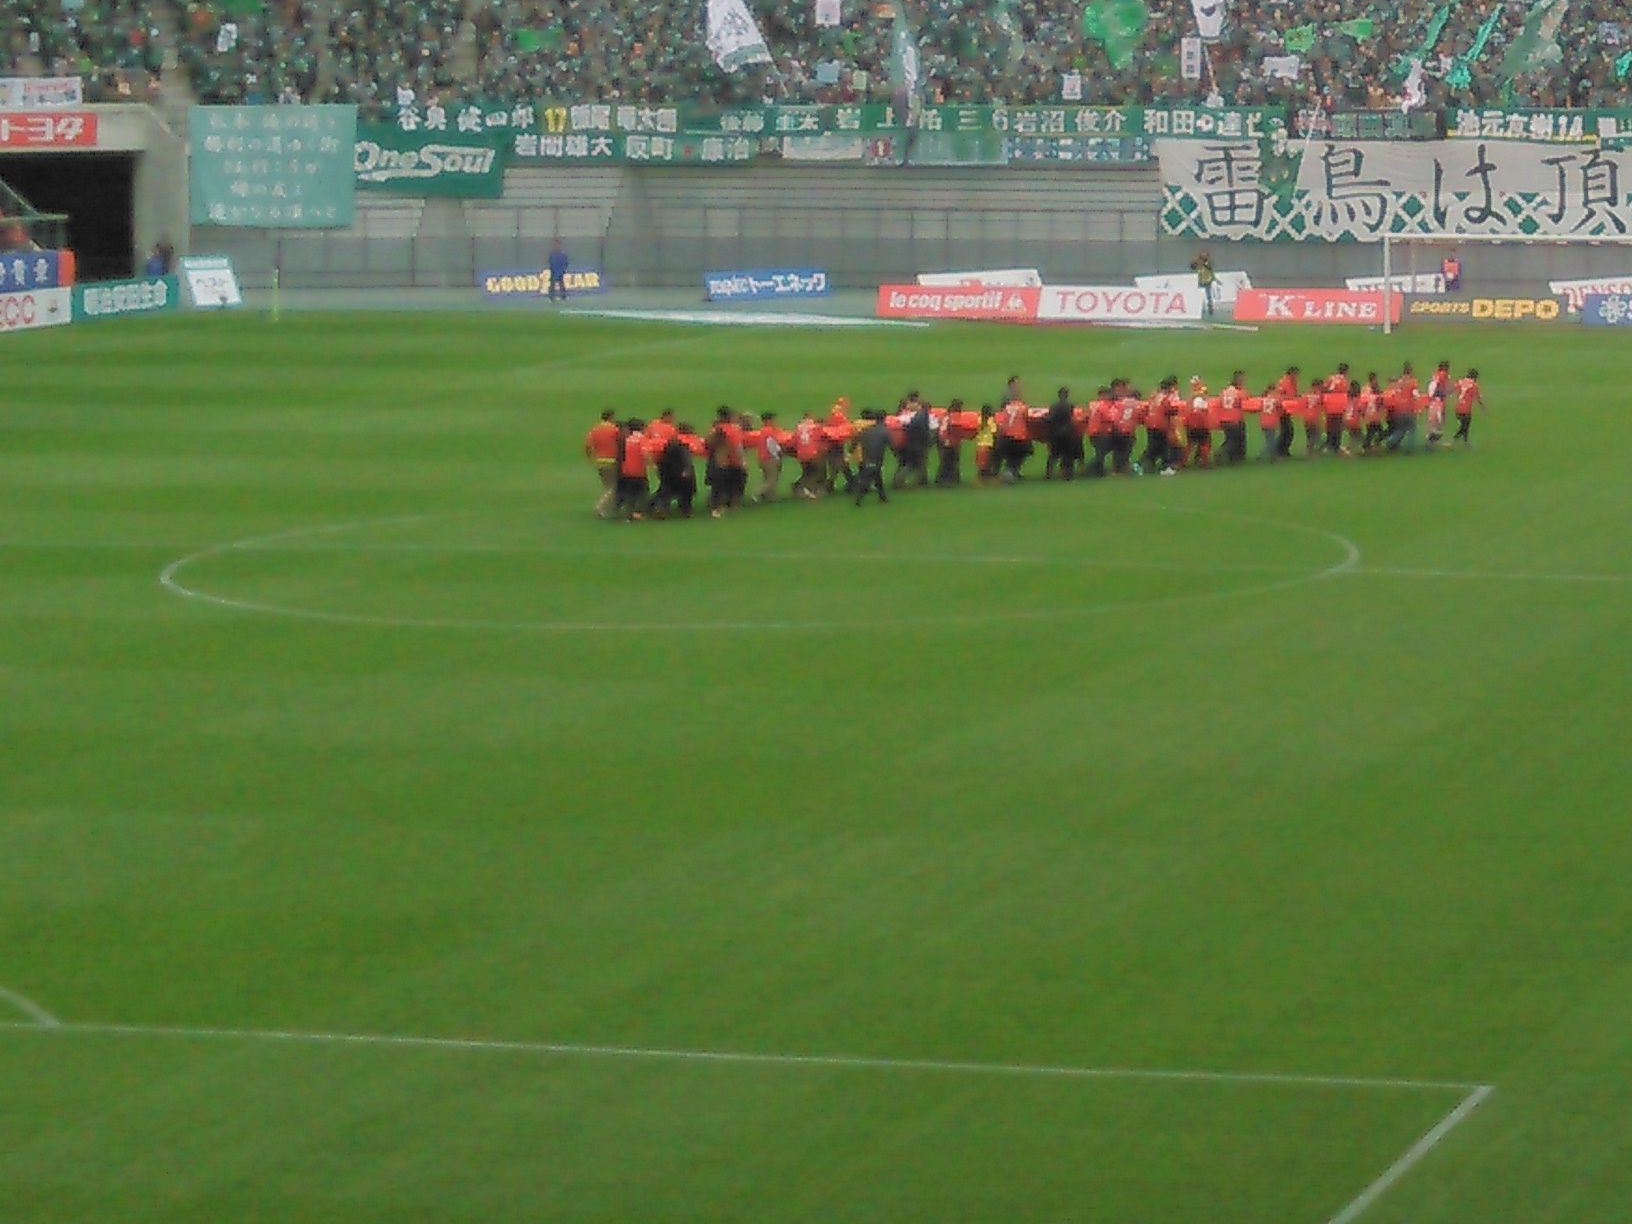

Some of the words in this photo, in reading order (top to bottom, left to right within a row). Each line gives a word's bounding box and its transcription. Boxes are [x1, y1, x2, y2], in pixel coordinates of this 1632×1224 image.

[1, 116, 85, 143] トヨタ
[1143, 109, 1195, 134] 和田
[889, 291, 905, 308] le
[907, 294, 942, 313] coq
[944, 291, 1004, 314] sportif
[1056, 291, 1188, 315] TOYOTA
[1304, 301, 1377, 320] LINE
[1410, 300, 1470, 314] SPORTS
[1471, 298, 1560, 322] DEPO
